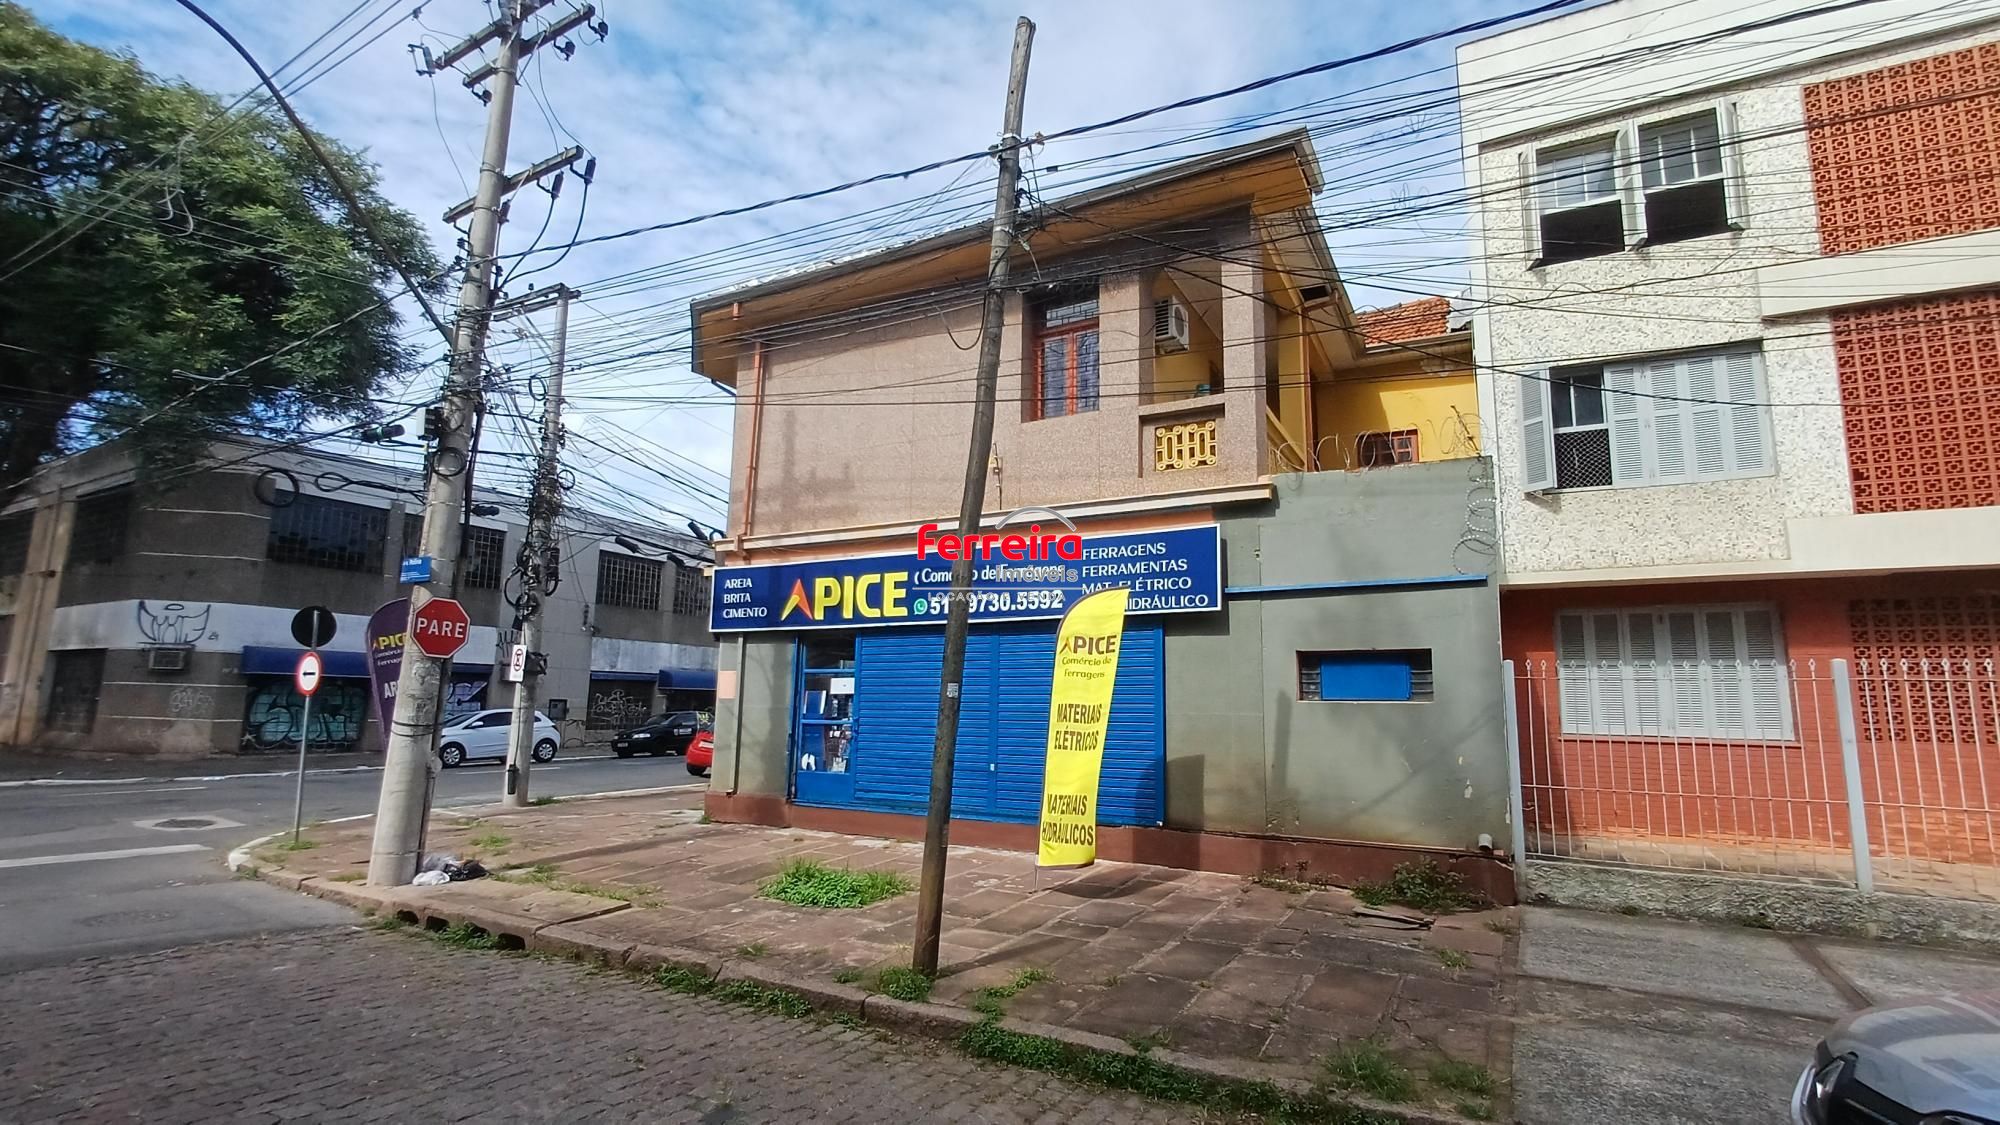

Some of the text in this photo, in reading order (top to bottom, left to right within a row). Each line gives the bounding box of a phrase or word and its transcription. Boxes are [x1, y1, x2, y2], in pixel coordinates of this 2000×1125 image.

[1083, 542, 1166, 560] FERRAGENS
[981, 565, 995, 581] de
[1082, 559, 1188, 578] FERRAMENTAS
[724, 578, 752, 589] AREIA
[724, 594, 751, 604] BRITA
[723, 607, 767, 619] CIMENTO
[416, 617, 466, 638] PARE
[1057, 703, 1102, 724] MATERIAIS
[1054, 727, 1099, 751] ELÉTRICOS
